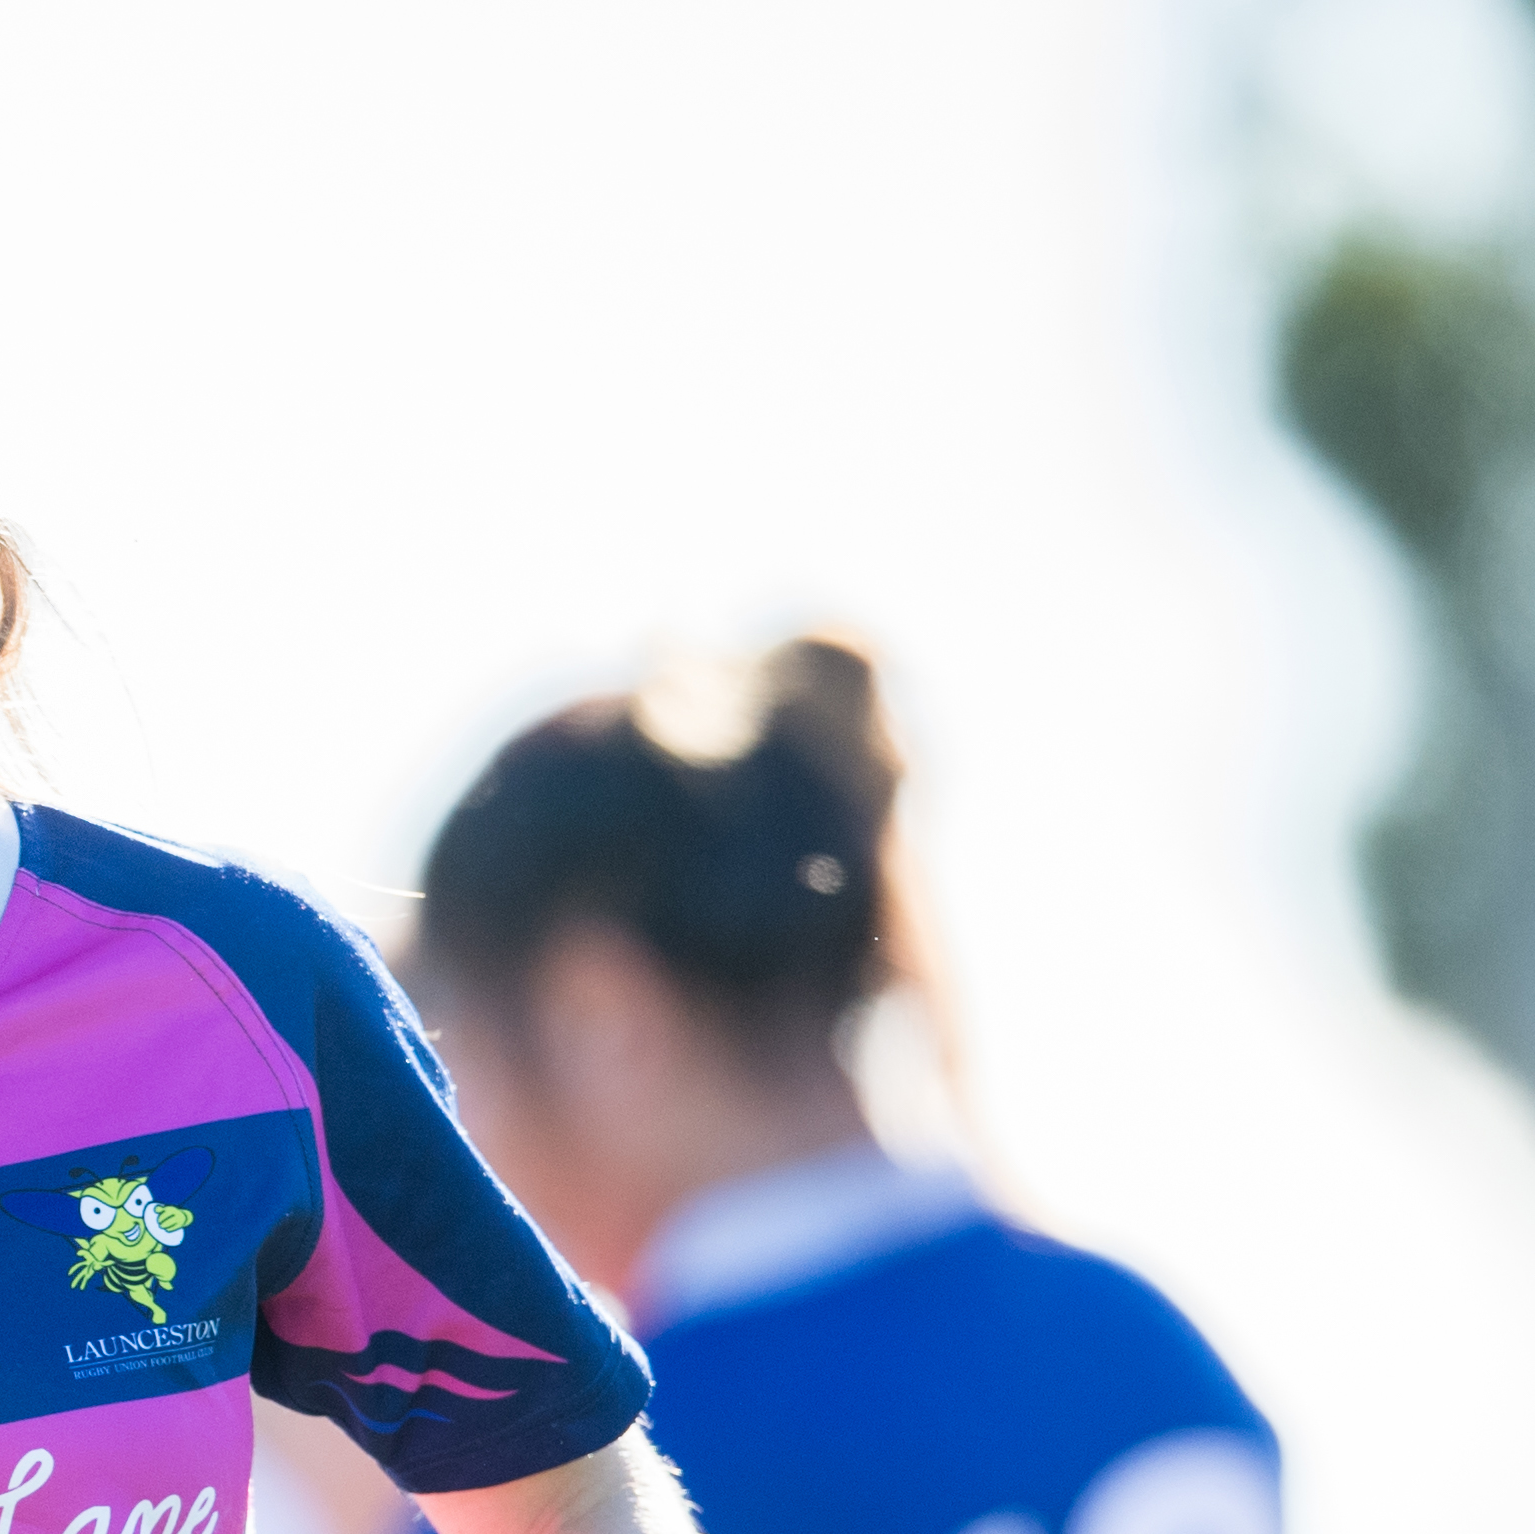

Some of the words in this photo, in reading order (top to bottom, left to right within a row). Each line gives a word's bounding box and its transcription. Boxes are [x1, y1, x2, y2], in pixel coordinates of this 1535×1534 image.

[63, 1317, 221, 1363] LAUNCESTON
[74, 1365, 111, 1380] RUGBY
[114, 1359, 147, 1373] UNION
